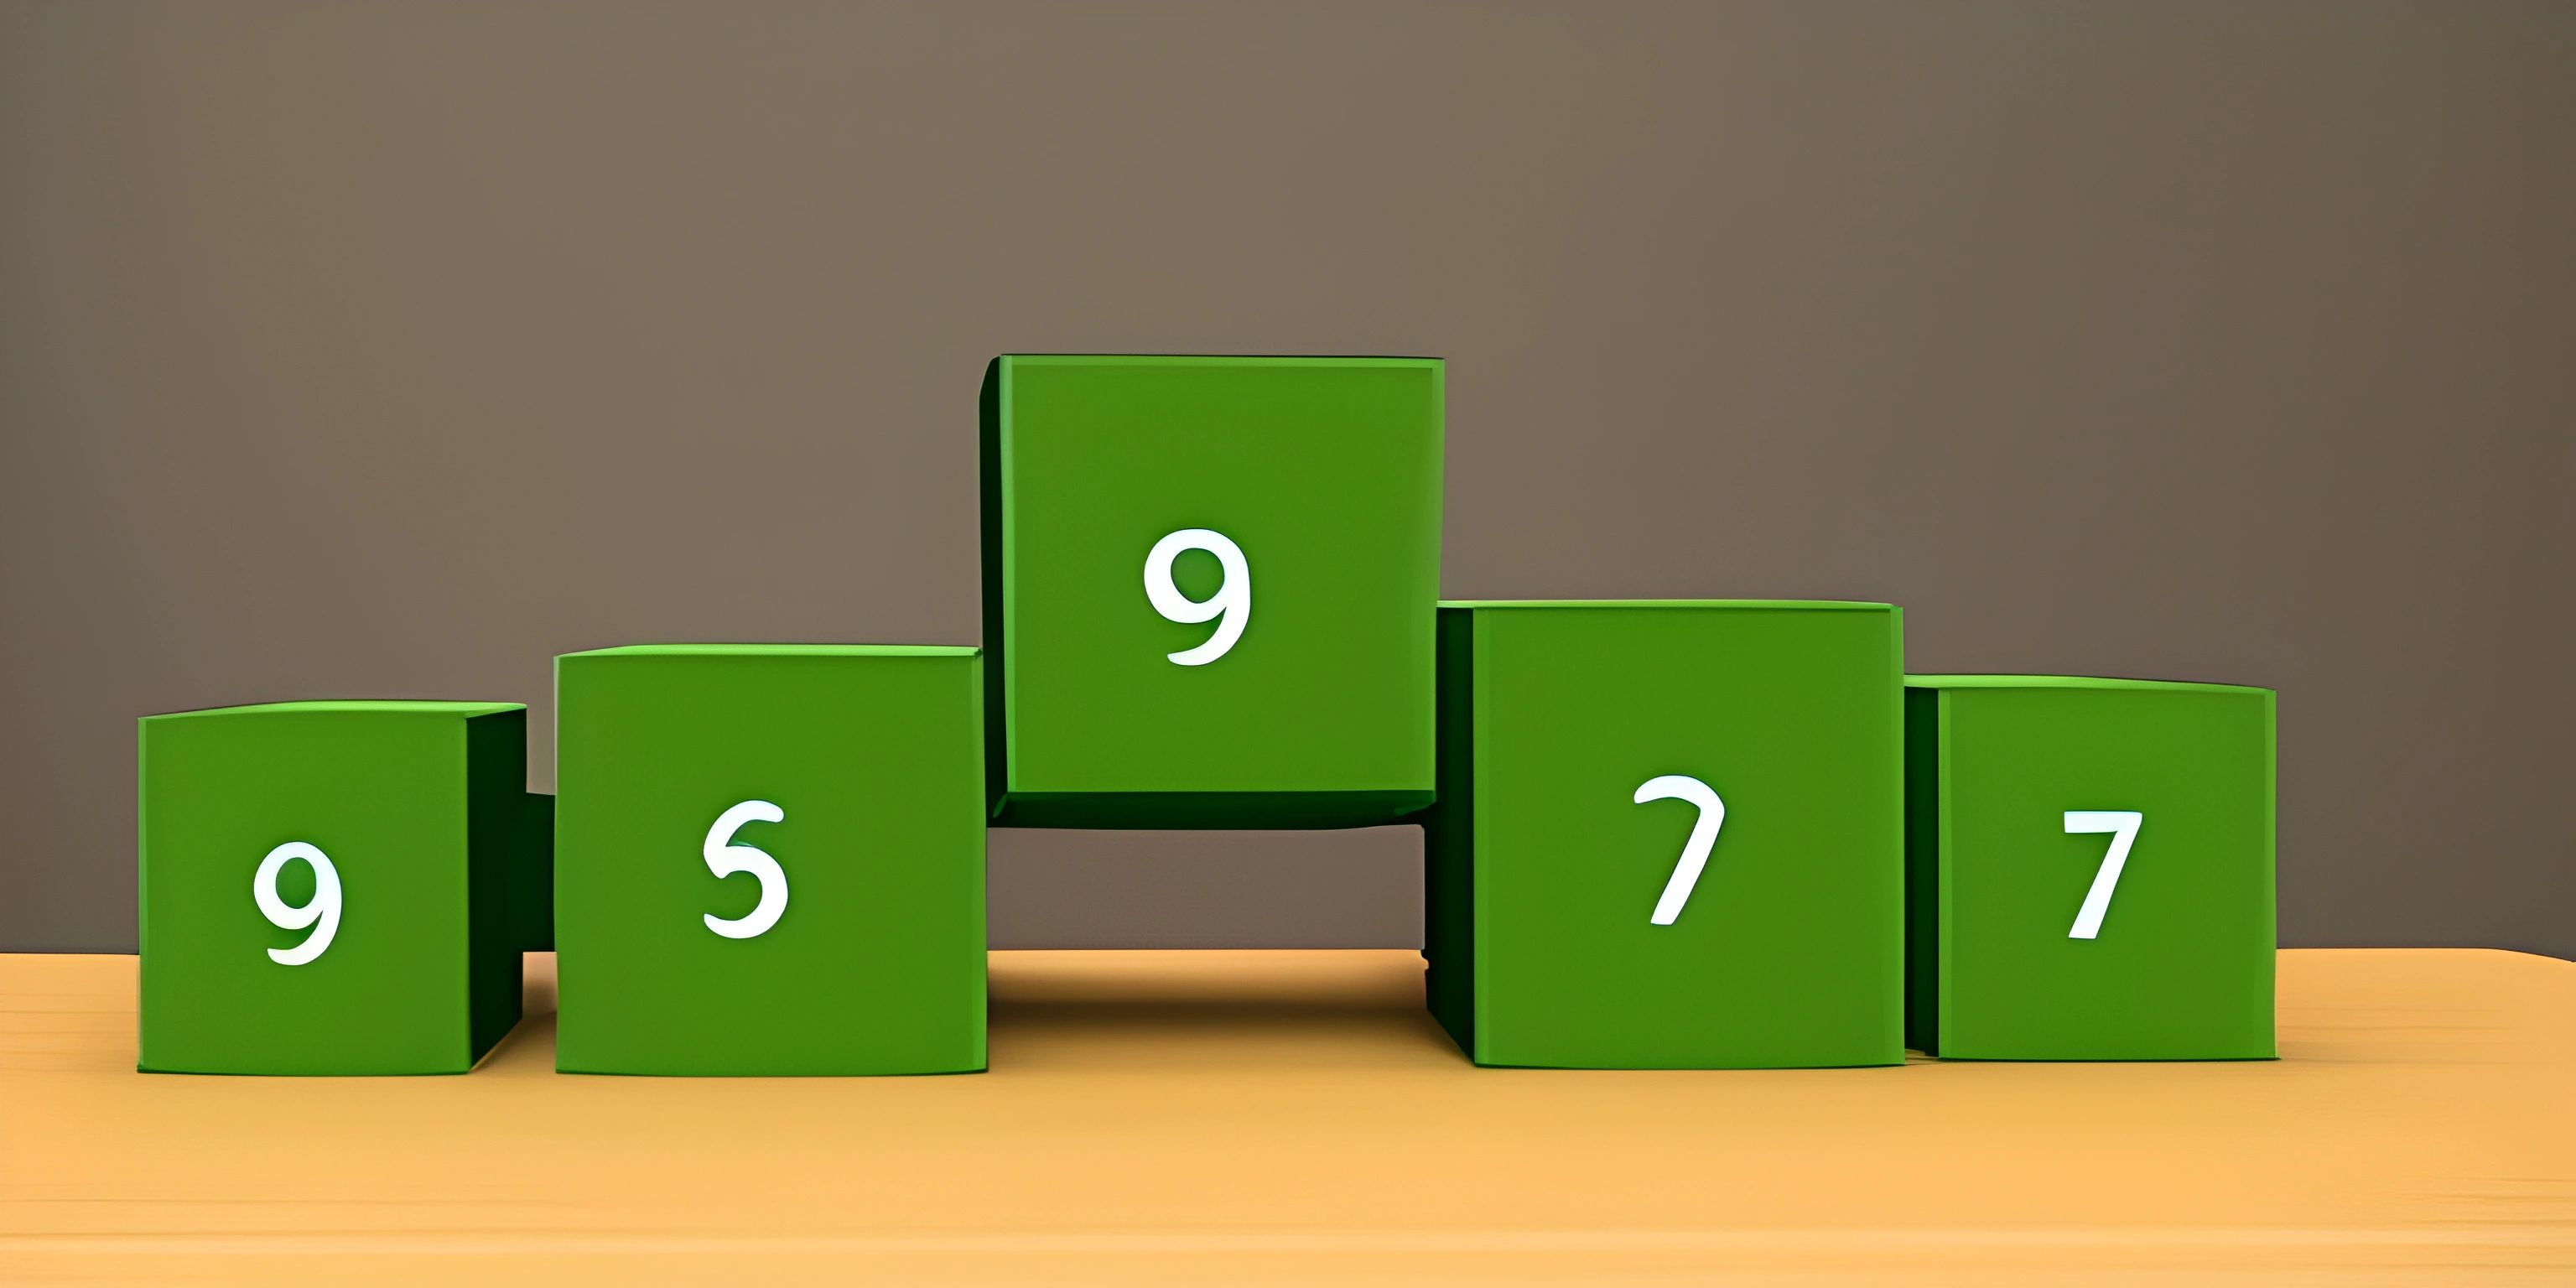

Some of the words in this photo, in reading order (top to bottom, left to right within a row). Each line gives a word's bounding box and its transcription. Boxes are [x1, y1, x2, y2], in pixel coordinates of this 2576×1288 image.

[1144, 528, 1251, 666] 9
[253, 841, 342, 966] 9
[703, 800, 788, 939] 5
[1633, 775, 1725, 926] 7
[2064, 811, 2142, 939] 7
